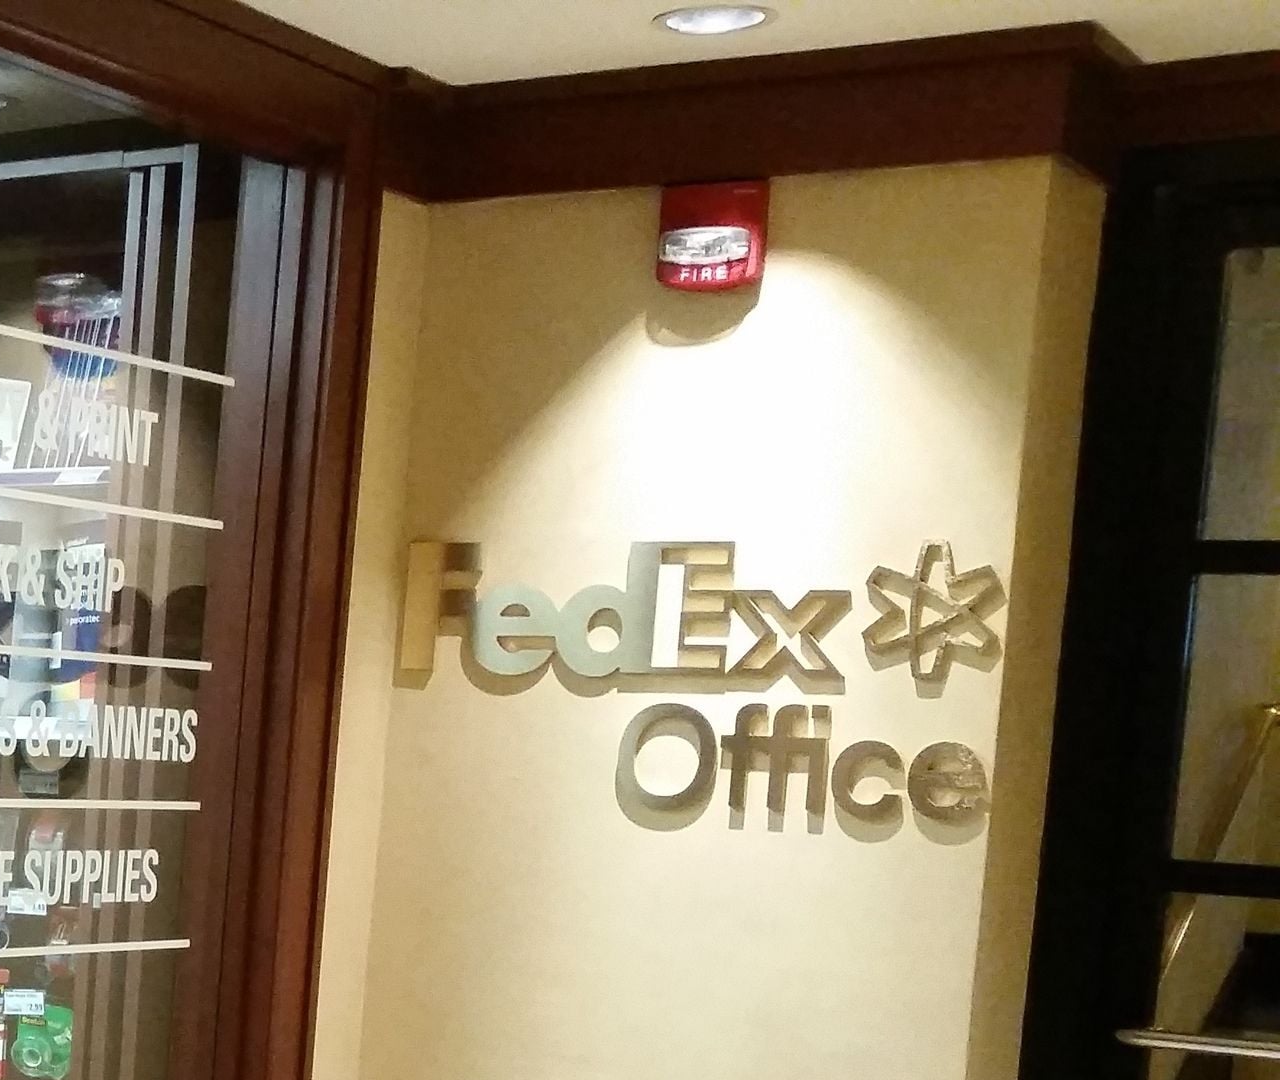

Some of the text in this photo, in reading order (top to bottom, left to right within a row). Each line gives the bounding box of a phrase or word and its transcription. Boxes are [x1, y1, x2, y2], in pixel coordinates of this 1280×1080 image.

[679, 265, 729, 282] FIRE
[33, 386, 59, 452] &
[67, 396, 159, 467] PRINT
[18, 547, 46, 607] &
[404, 541, 852, 691] FedEx
[25, 699, 50, 758] &
[60, 701, 199, 764] BANNERS
[616, 702, 989, 832] Office
[23, 847, 160, 906] SUPPLIES
